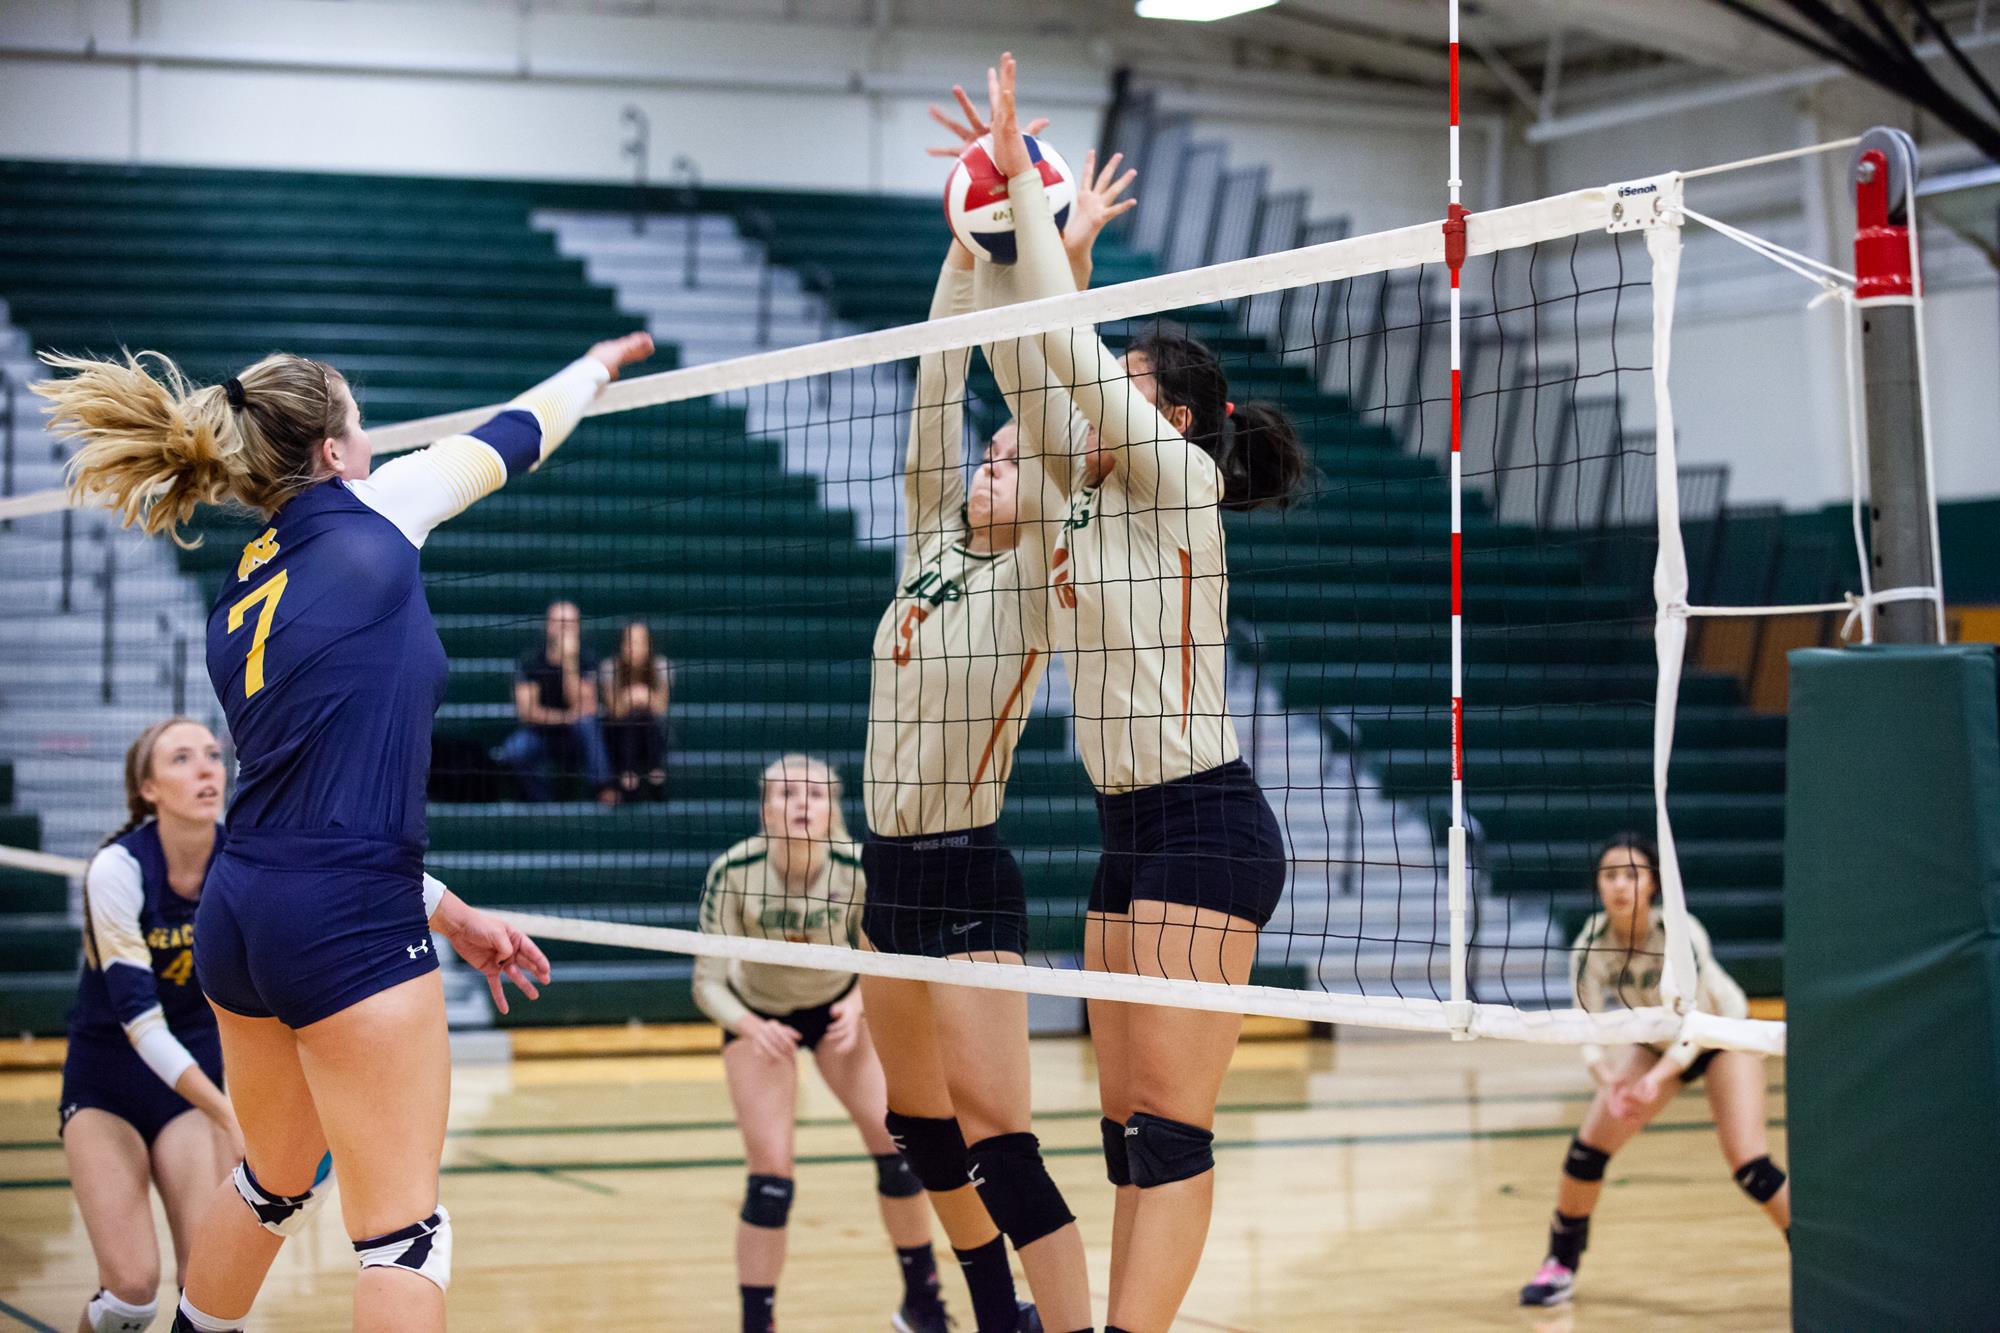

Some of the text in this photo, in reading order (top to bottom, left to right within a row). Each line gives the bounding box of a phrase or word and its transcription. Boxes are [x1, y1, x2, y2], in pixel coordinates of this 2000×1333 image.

[227, 568, 288, 699] 7
[892, 605, 928, 667] 5
[160, 949, 193, 986] 4
